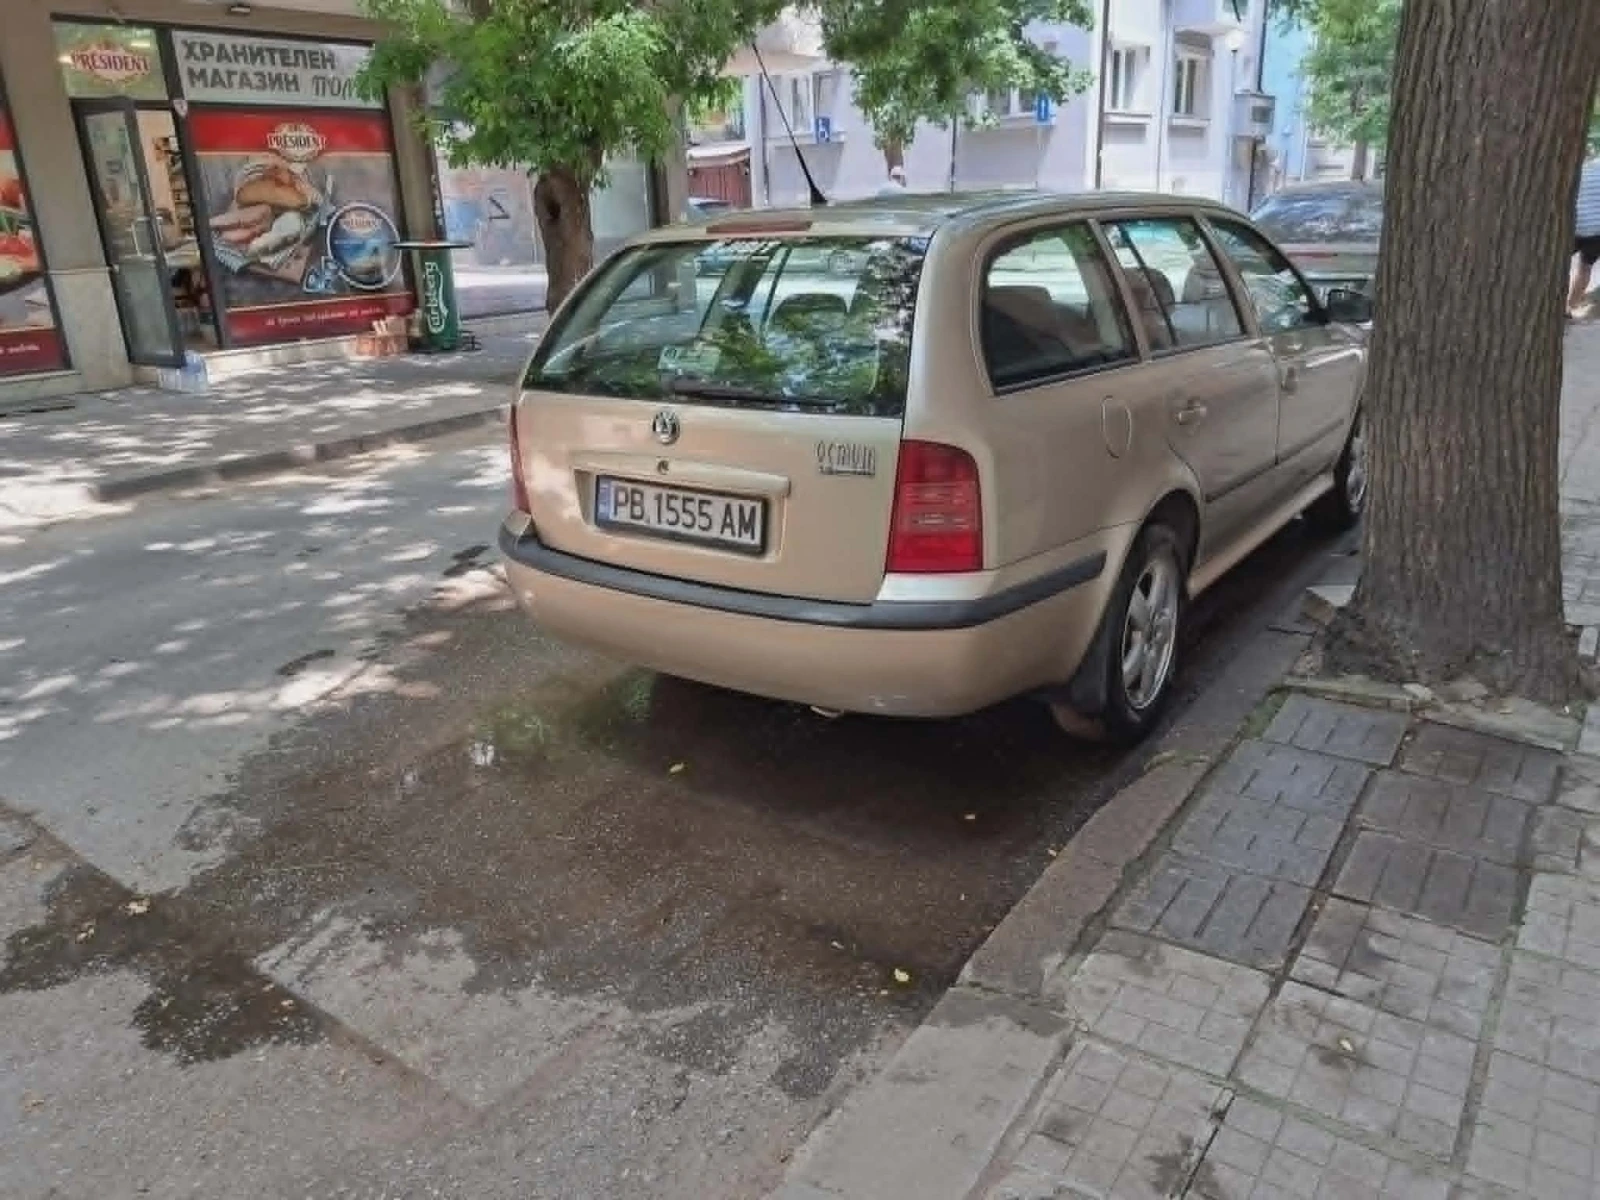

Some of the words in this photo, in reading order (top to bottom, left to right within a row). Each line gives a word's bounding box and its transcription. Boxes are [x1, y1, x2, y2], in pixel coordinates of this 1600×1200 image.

[180, 39, 336, 70] ХРАНИТЕЛЕН
[186, 66, 300, 93] МАГАЗИН
[653, 492, 713, 532] 1555
[720, 502, 757, 541] AM
